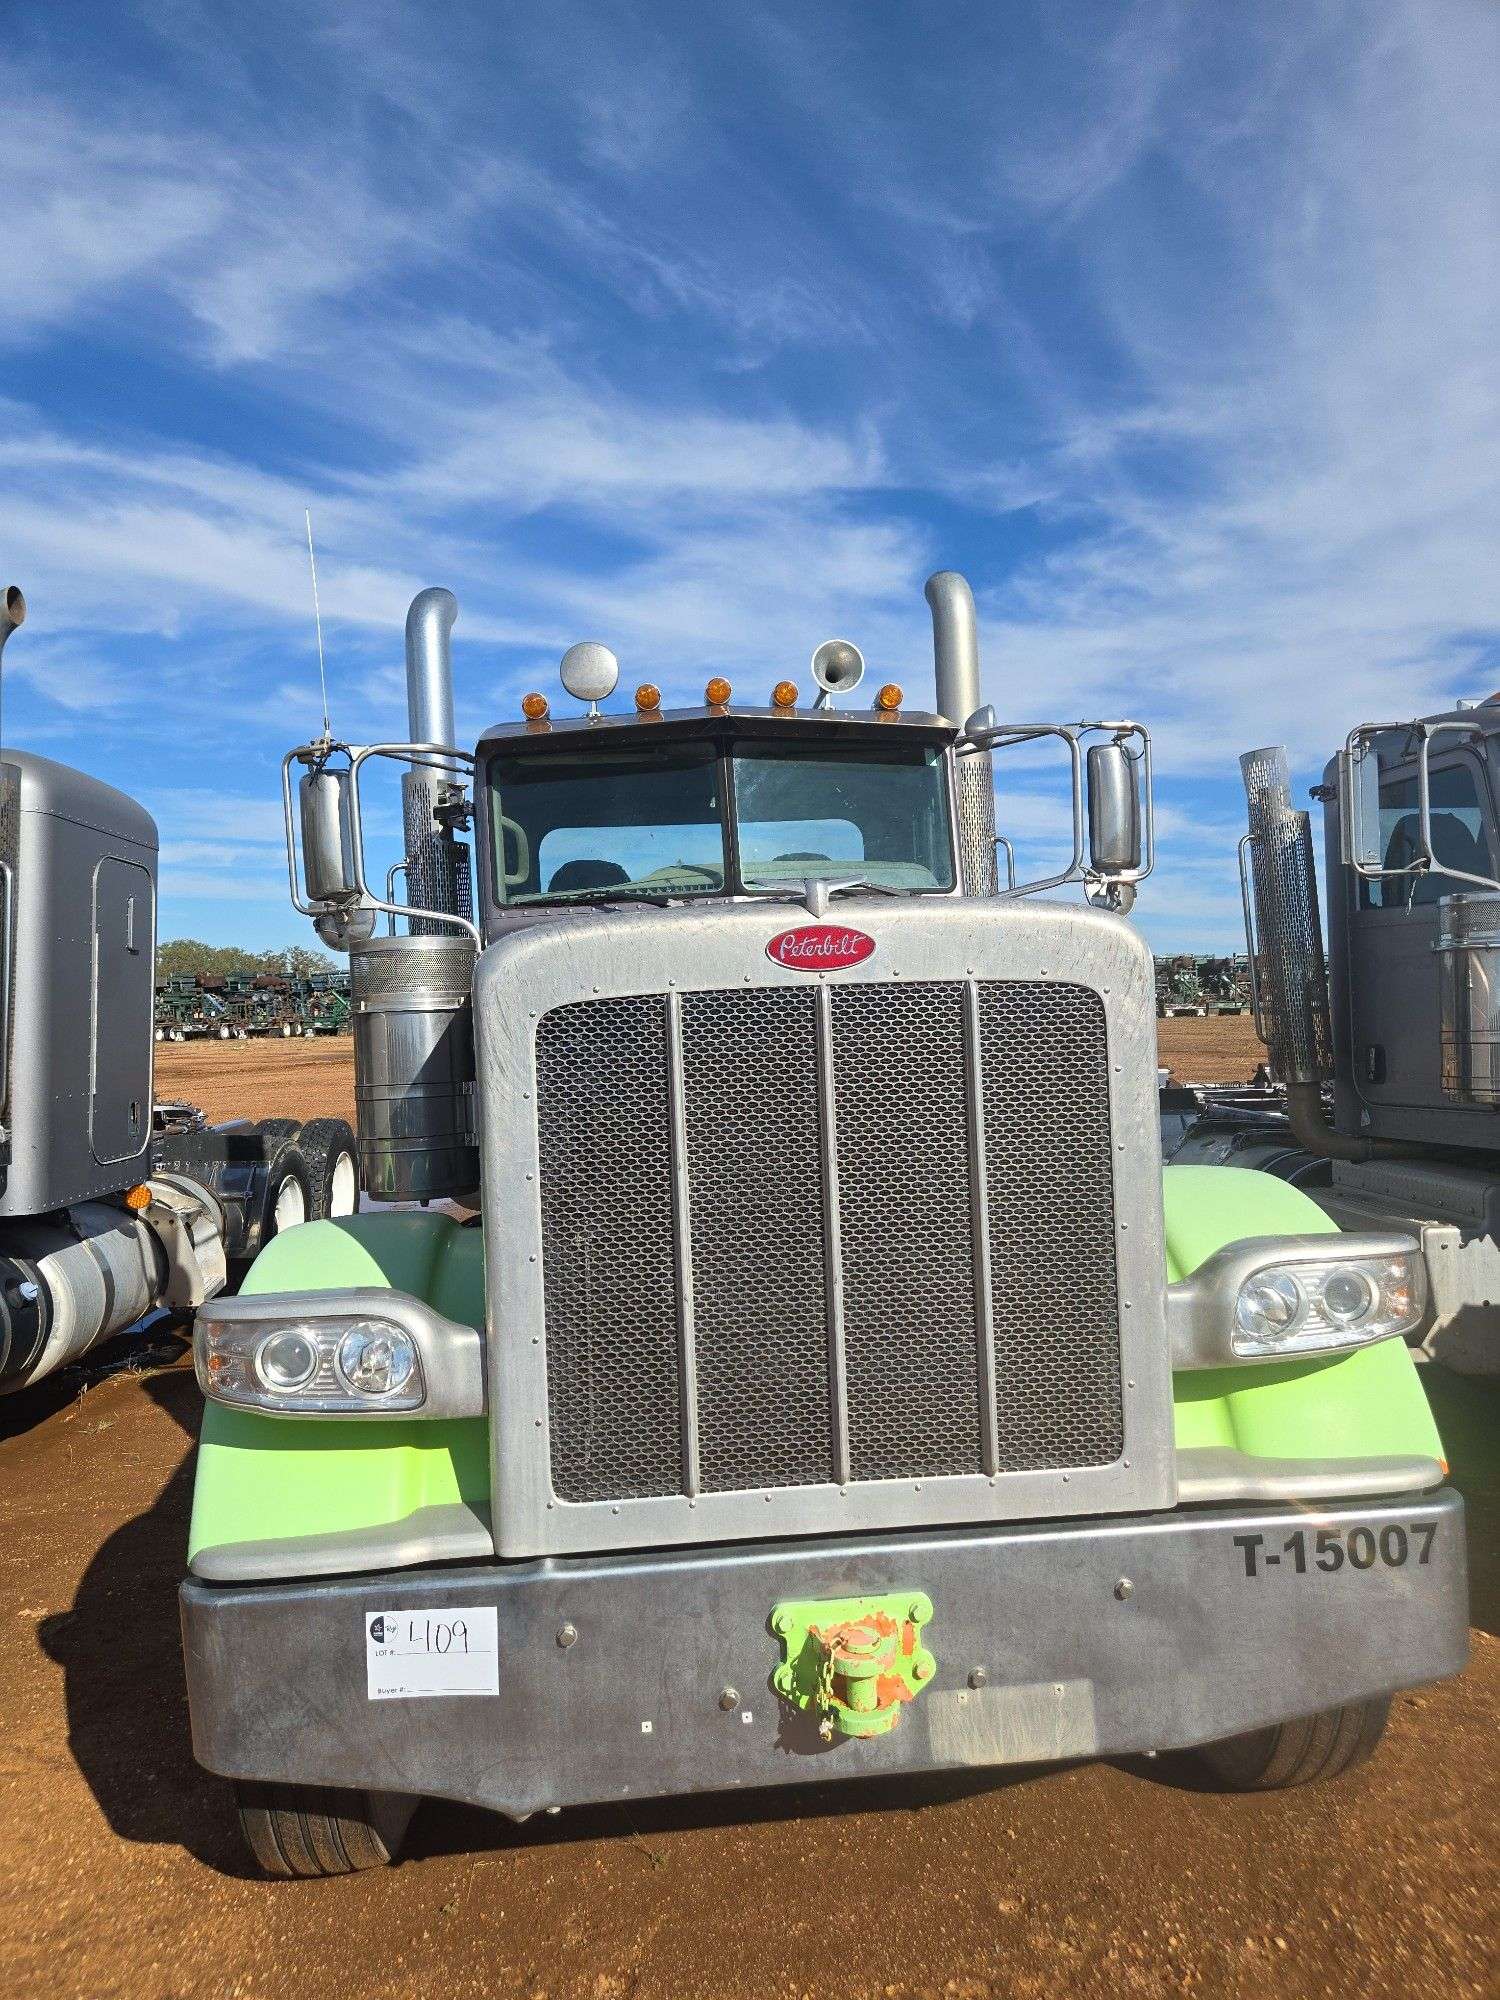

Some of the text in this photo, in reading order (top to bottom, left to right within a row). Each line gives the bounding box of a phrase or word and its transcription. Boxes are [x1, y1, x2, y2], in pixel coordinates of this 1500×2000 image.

[780, 934, 867, 960] Peterbilt
[1233, 1522, 1438, 1576] T-15007
[409, 1619, 468, 1653] 409
